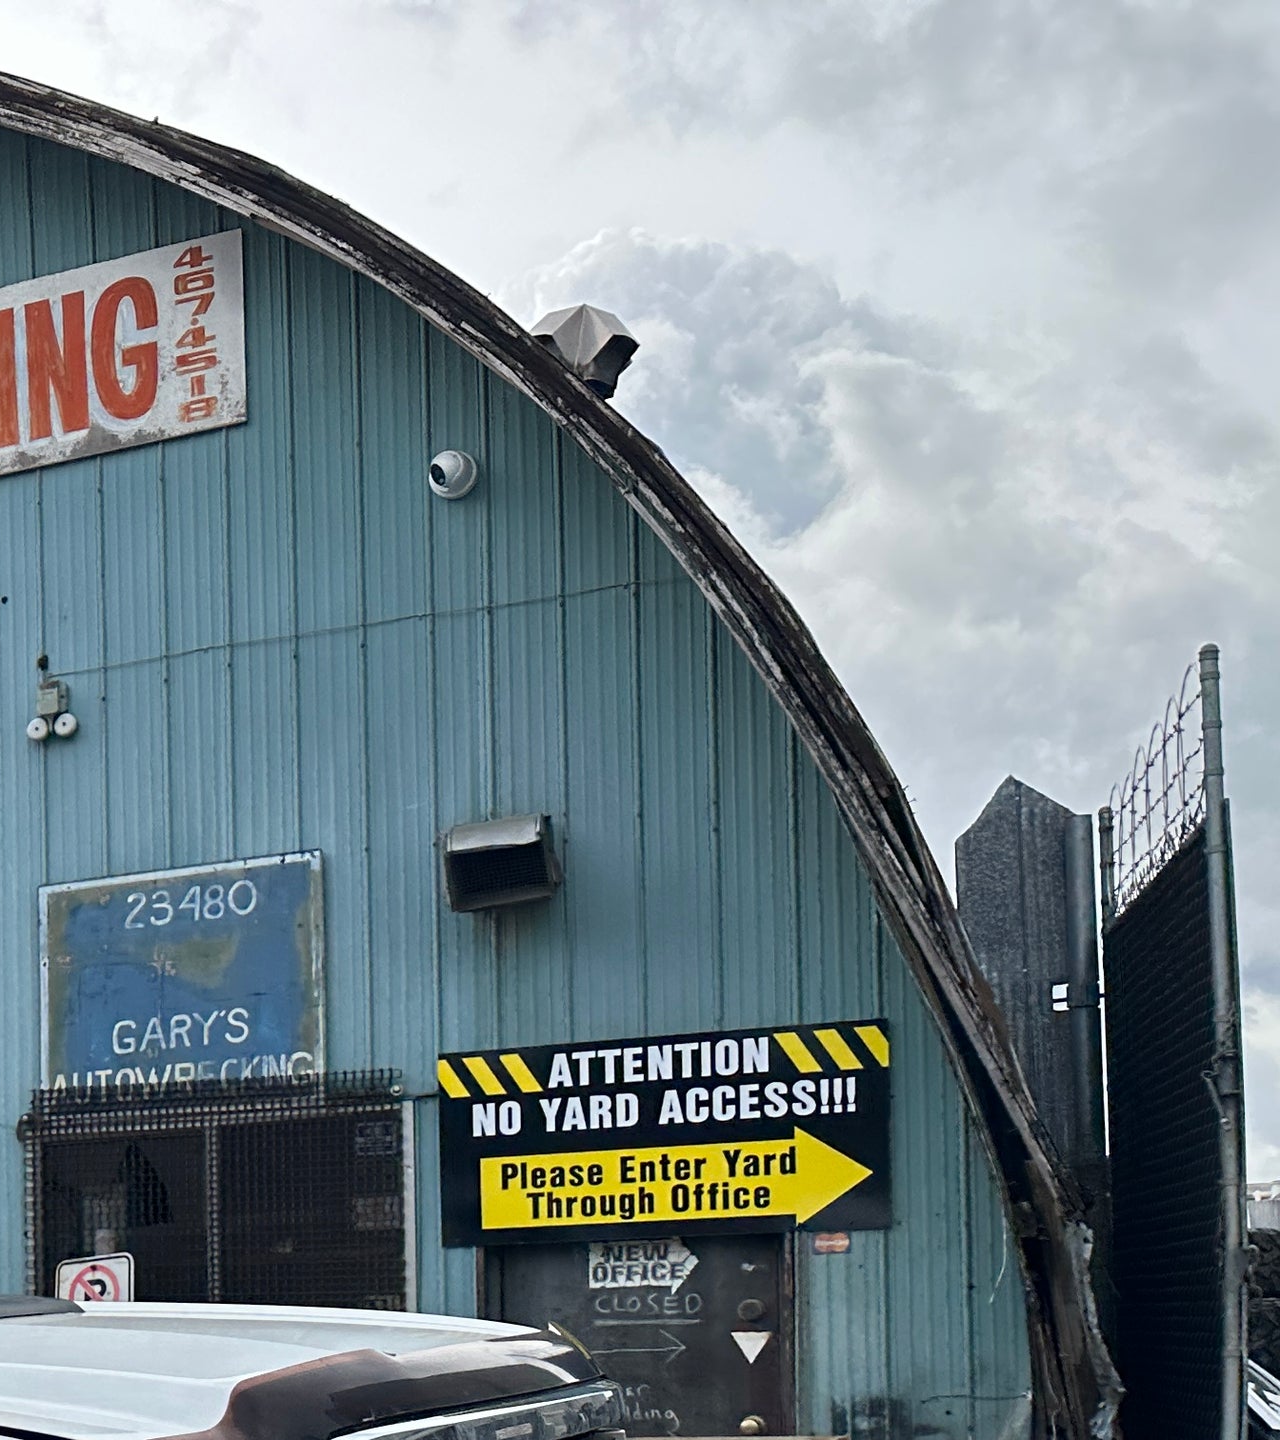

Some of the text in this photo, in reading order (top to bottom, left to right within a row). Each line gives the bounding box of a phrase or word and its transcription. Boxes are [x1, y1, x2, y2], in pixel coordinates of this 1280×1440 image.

[124, 879, 257, 929] 23480
[112, 1008, 250, 1055] GARY'S
[548, 1037, 770, 1089] ATTENTION
[472, 1077, 857, 1138] NO YARD ACCESS!!!
[501, 1146, 798, 1190] Please Enter Yard
[526, 1183, 771, 1220] Through Office
[592, 1263, 686, 1284] OFFICE
[603, 1244, 669, 1263] NEW
[595, 1293, 703, 1314] CLOSED
